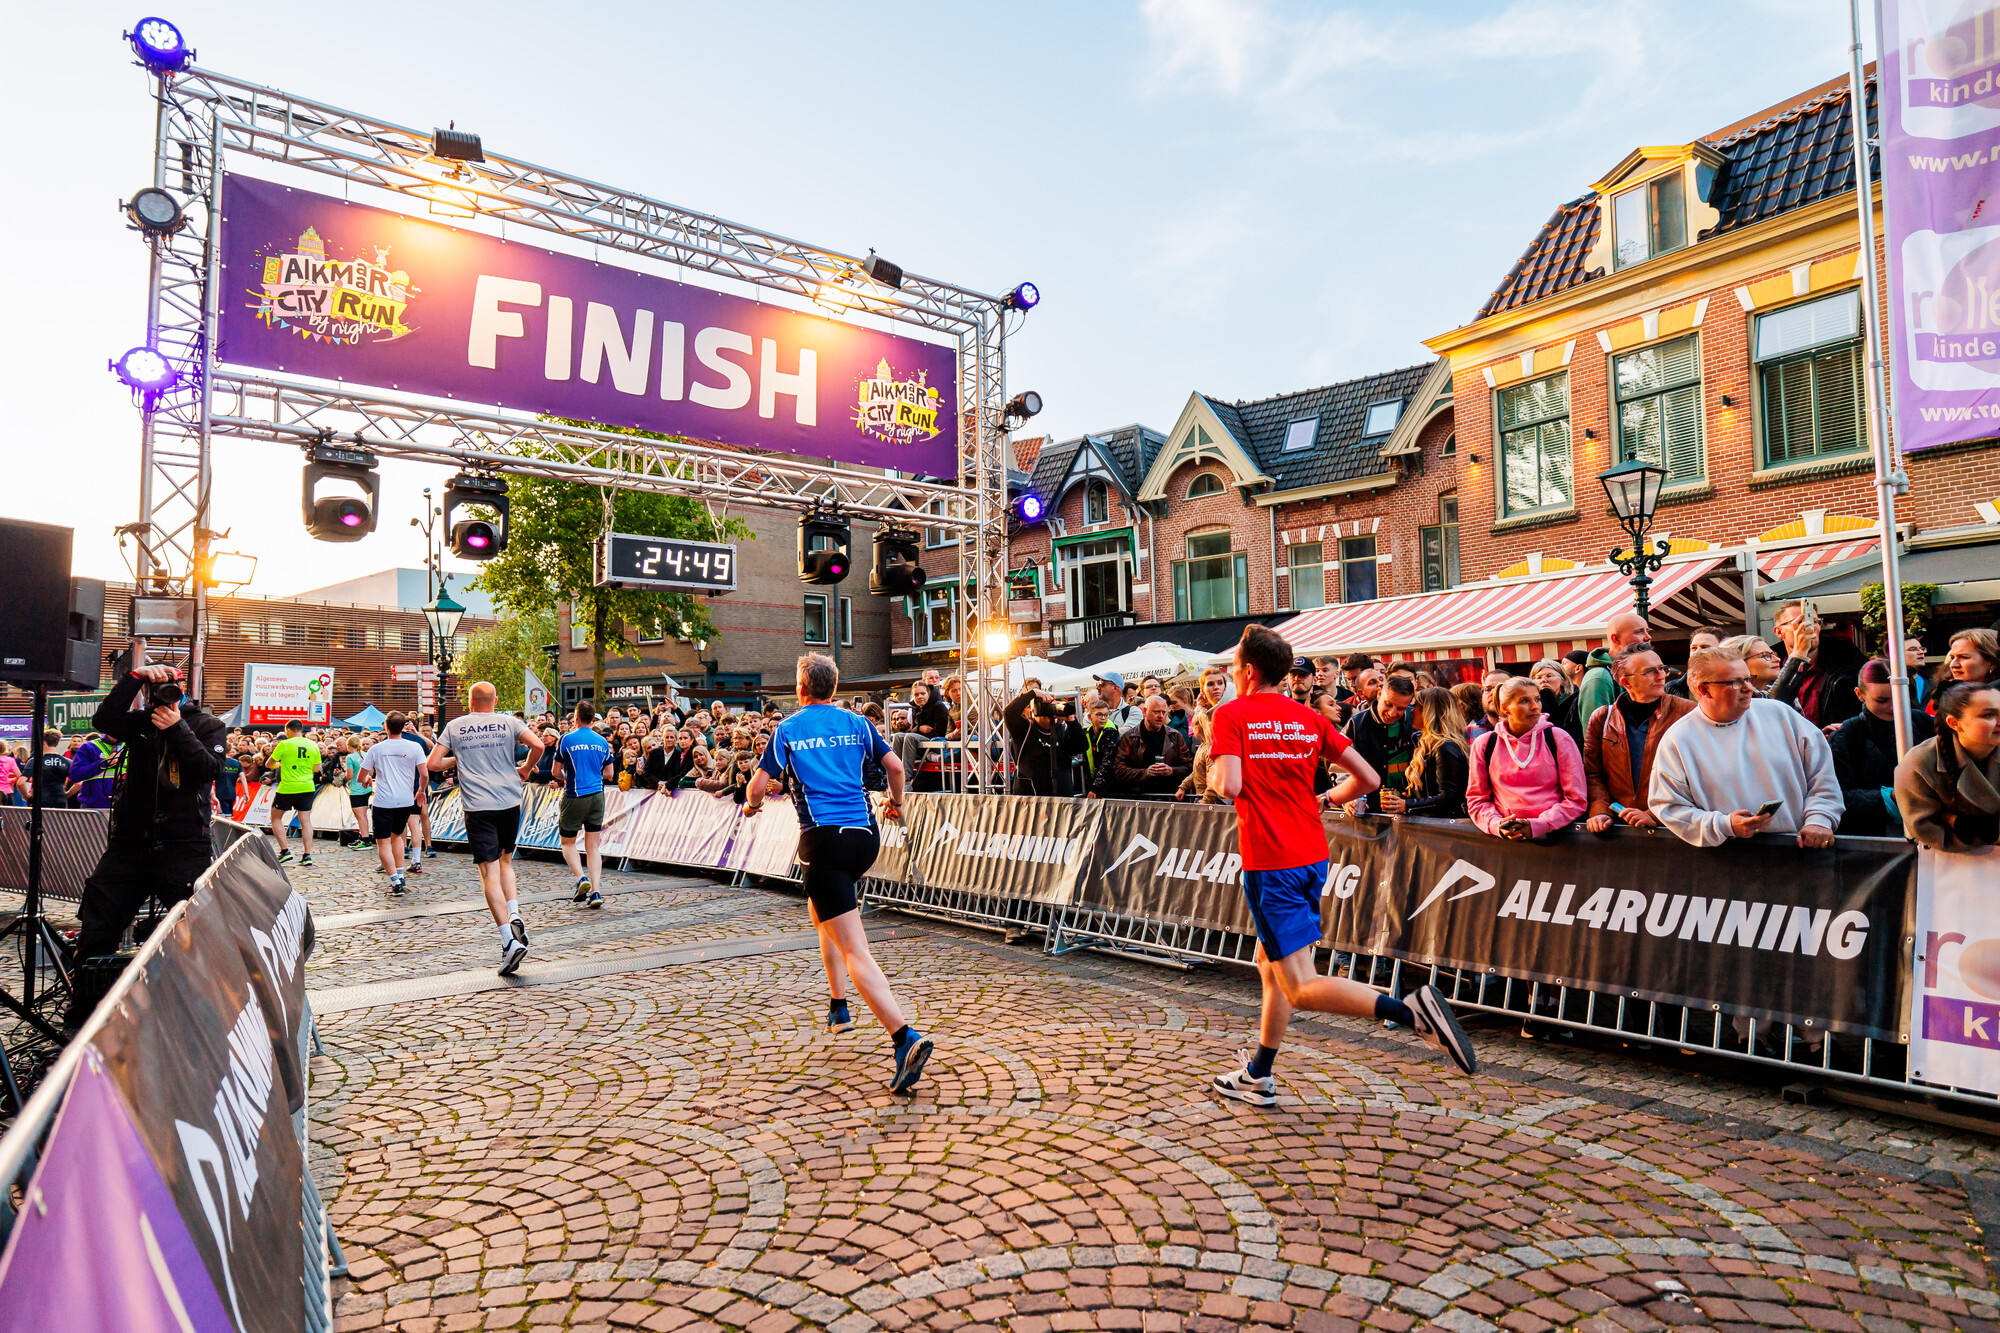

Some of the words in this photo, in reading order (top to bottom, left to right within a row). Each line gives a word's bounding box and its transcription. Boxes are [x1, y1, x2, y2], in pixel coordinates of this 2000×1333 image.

[309, 309, 329, 334] by
[331, 315, 381, 344] night
[468, 275, 817, 427] FINISH
[884, 423, 896, 437] by
[896, 424, 924, 443] night
[635, 547, 730, 580] :24:49
[611, 685, 653, 698] IJSPLEIN
[459, 724, 506, 734] SAMEN
[1247, 721, 1272, 729] word
[1273, 721, 1282, 732] jij
[1284, 722, 1305, 732] mijn
[789, 738, 826, 751] TATA
[829, 734, 864, 748] STEEL
[1248, 731, 1281, 740] nieuwe
[1282, 732, 1318, 743] collega?
[956, 831, 1079, 865] ALL4RUNNING
[1497, 879, 1870, 960] ALL4RUNNING
